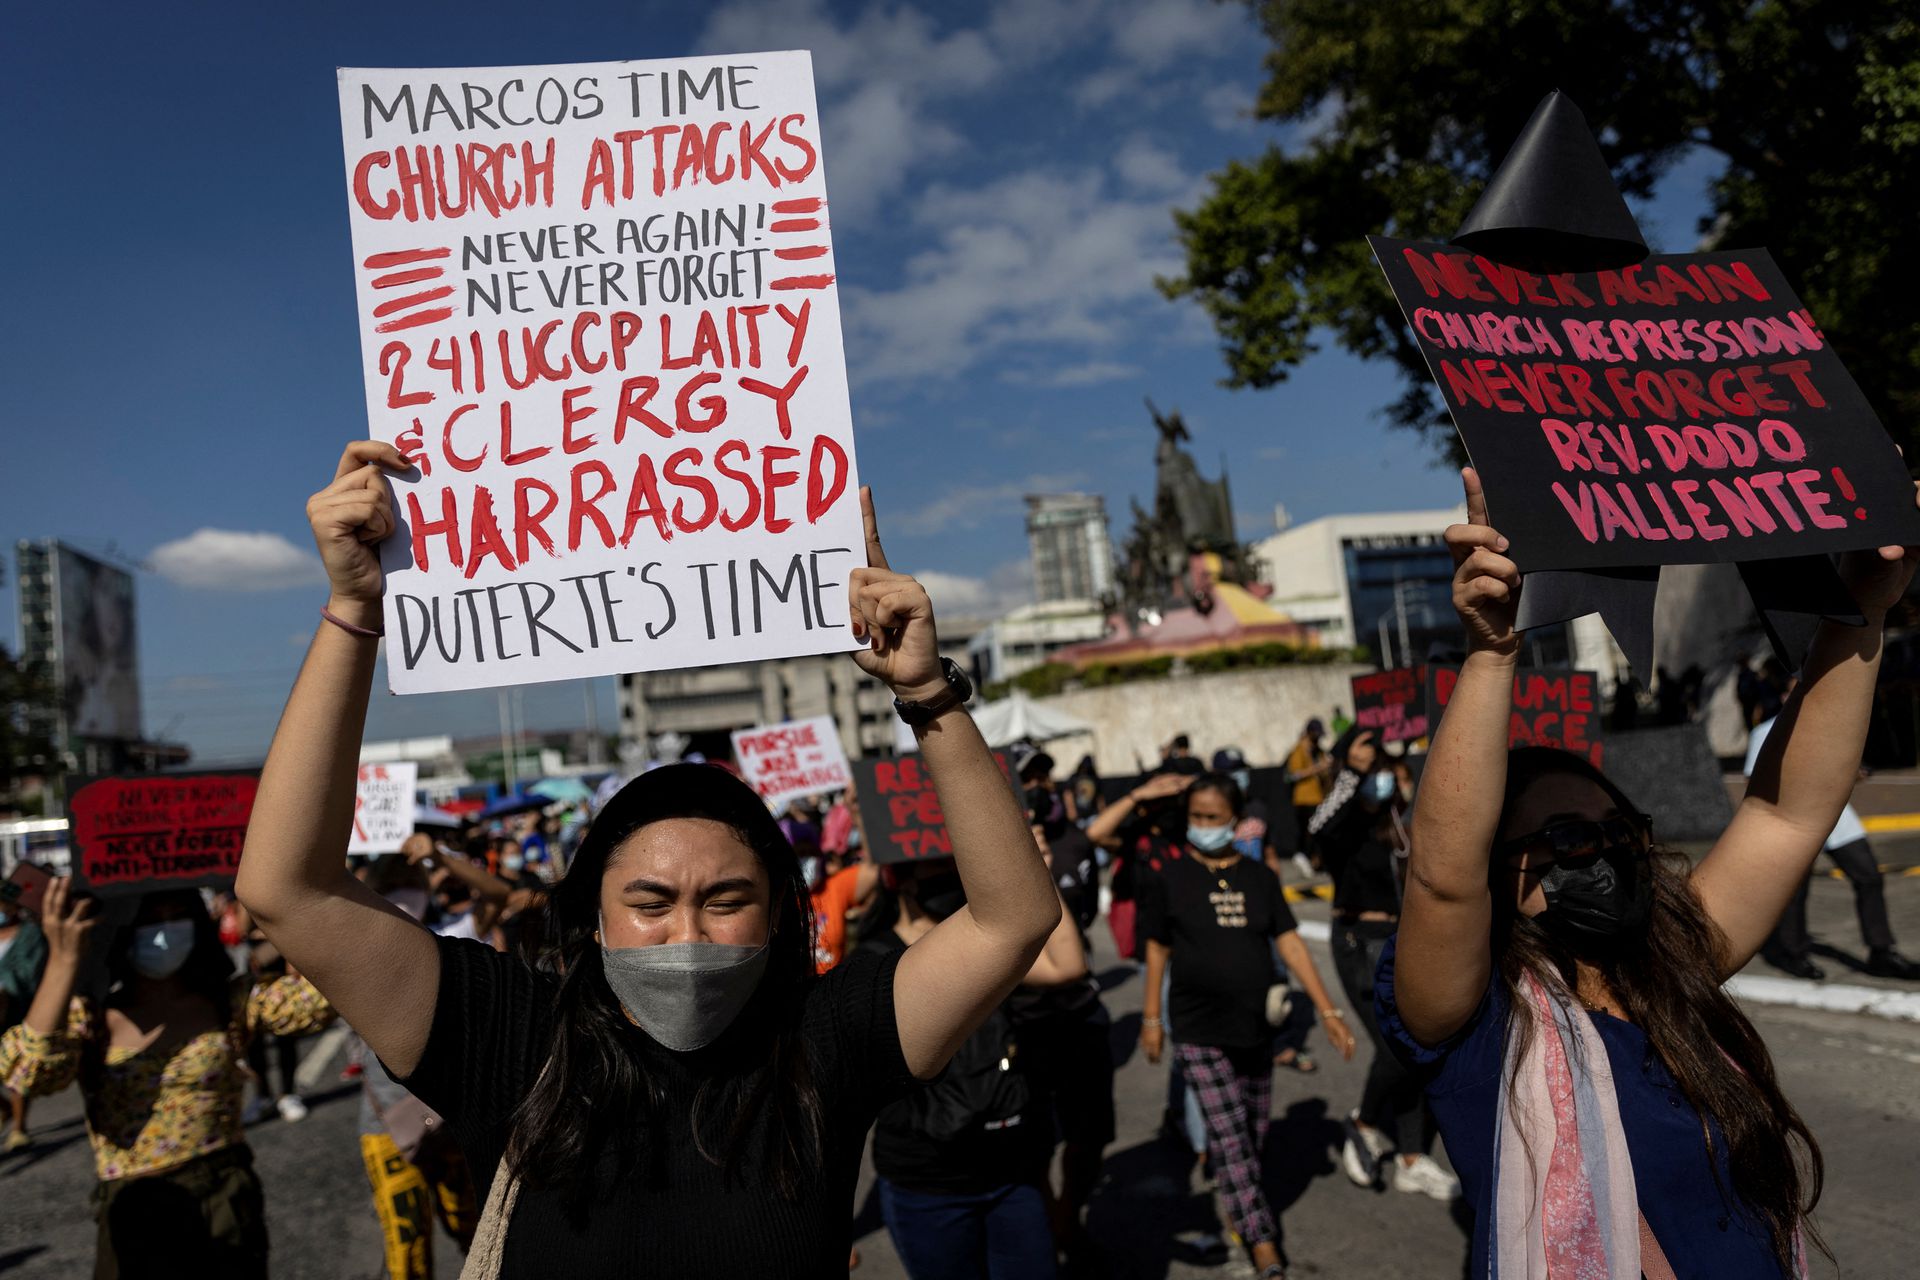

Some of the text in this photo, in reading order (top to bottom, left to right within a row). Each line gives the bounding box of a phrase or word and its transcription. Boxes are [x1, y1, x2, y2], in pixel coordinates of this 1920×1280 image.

[362, 65, 759, 139] MARCOS TIME
[353, 113, 817, 222] CHURCH ATTACKS
[462, 203, 765, 270] NEVER AGAIN!
[467, 248, 771, 317] NEVER FORGET
[1597, 262, 1772, 305] AGAIN
[379, 298, 811, 409] 241 UCCP LAITY
[1413, 307, 1563, 357] CHURCH
[442, 365, 808, 472] CLERGY
[1440, 359, 1826, 420] NEVER FORGET
[1541, 418, 1806, 475] REV. DODO
[407, 434, 848, 579] HARRASSED
[1551, 466, 1868, 544] VALLENTE!
[396, 548, 851, 670] DUTERTE'S TIME
